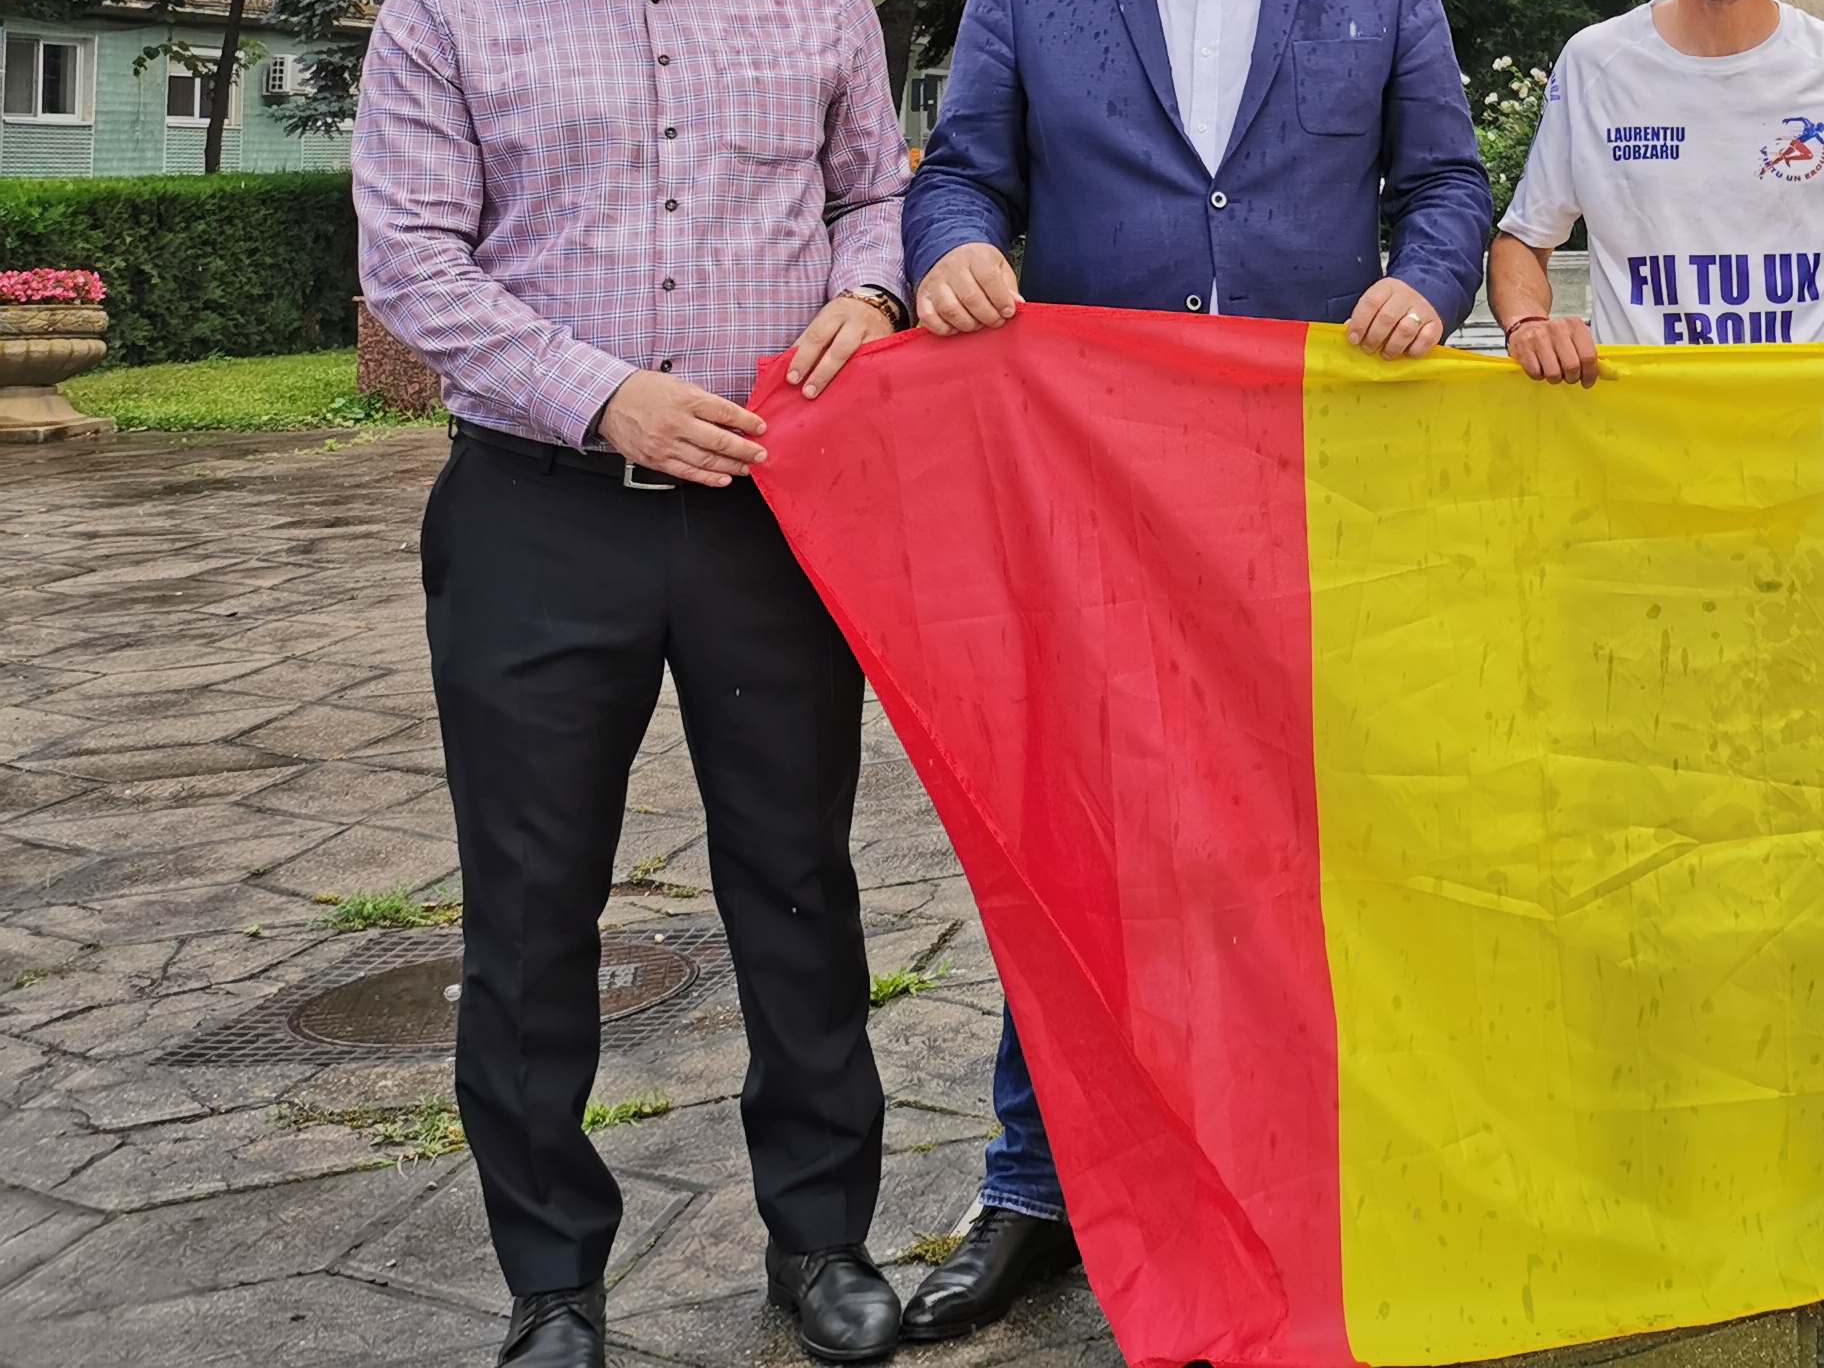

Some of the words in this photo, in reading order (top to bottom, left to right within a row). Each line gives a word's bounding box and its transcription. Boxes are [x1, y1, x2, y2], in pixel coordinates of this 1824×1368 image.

[1612, 144, 1680, 161] COBZARU
[1770, 166, 1783, 178] TU
[1627, 255, 1679, 306] FII
[1689, 254, 1750, 305] TU
[1763, 253, 1821, 304] UN
